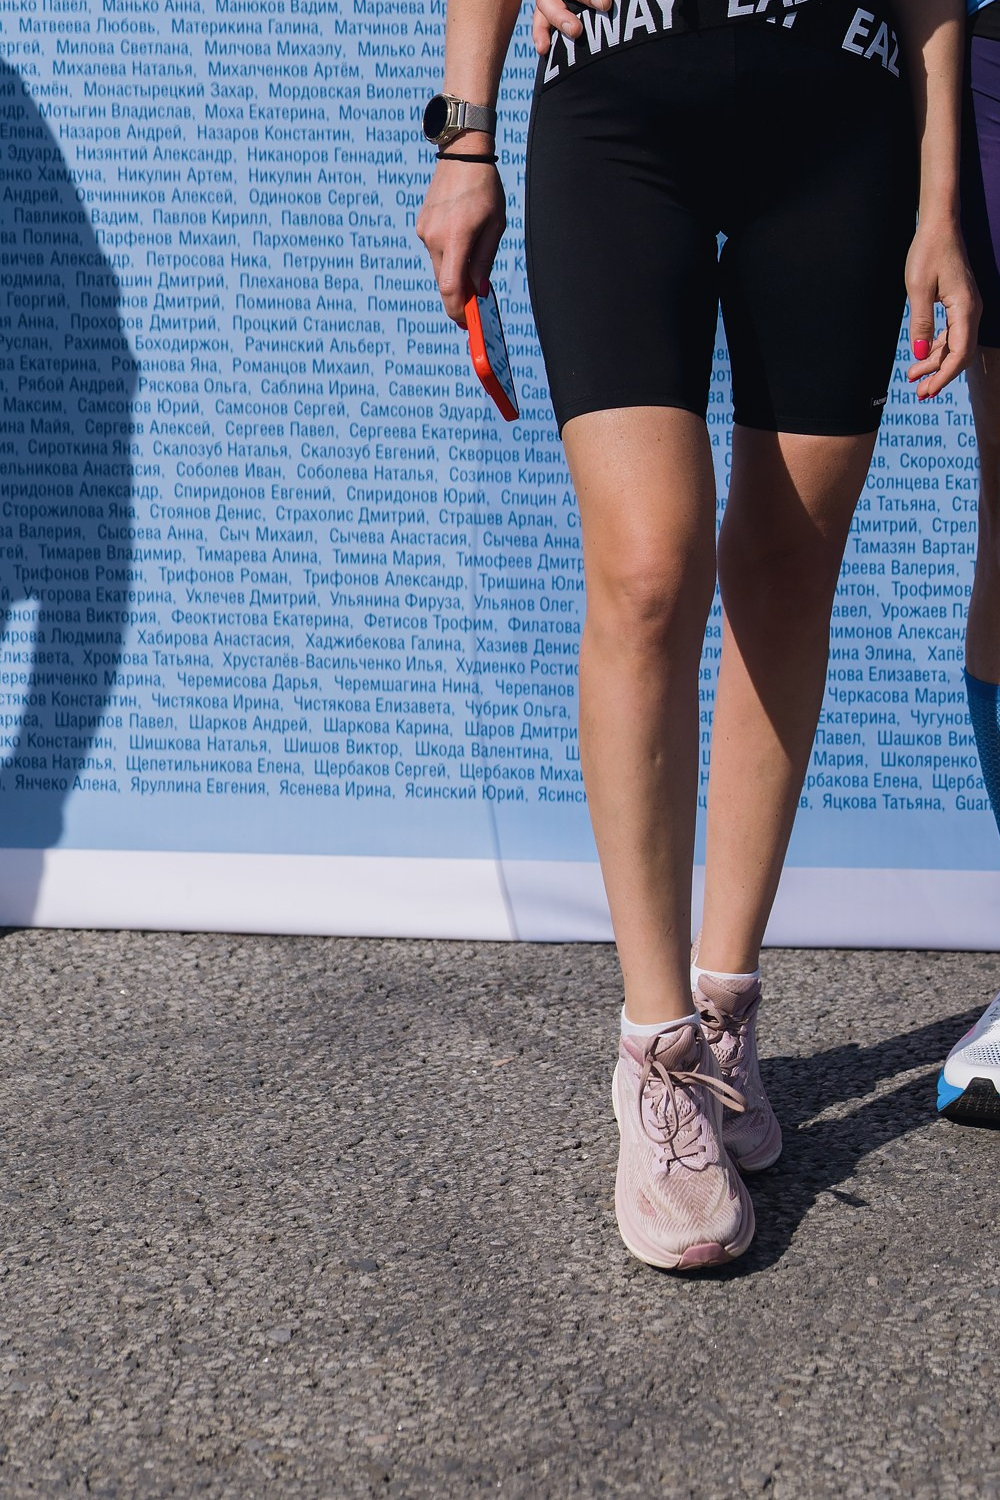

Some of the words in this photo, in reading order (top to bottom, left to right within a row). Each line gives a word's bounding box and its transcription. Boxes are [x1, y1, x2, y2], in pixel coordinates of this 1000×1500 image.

[84, 82, 204, 100] Монастырецкий
[211, 84, 257, 100] Захар,
[269, 83, 360, 100] Мордовская
[64, 335, 129, 351] Рахимов
[136, 336, 232, 353] Боходиржон,
[246, 337, 323, 352] Рачинский
[330, 338, 395, 356] Альберт,
[175, 483, 264, 500] Спиридонов
[272, 485, 334, 501] Евгений,
[346, 487, 438, 503] Спиридонов
[444, 488, 489, 506] Юрий,
[15, 774, 67, 792] Янчеко
[73, 775, 120, 792] Алена,
[132, 777, 200, 794] Яруллина
[207, 779, 270, 795] Евгения,
[280, 781, 340, 796] Ясенева
[346, 782, 395, 799] Ирина,
[406, 783, 475, 798] Ясинский
[823, 794, 876, 810] Яцкова
[883, 794, 944, 811] Татьяна,
